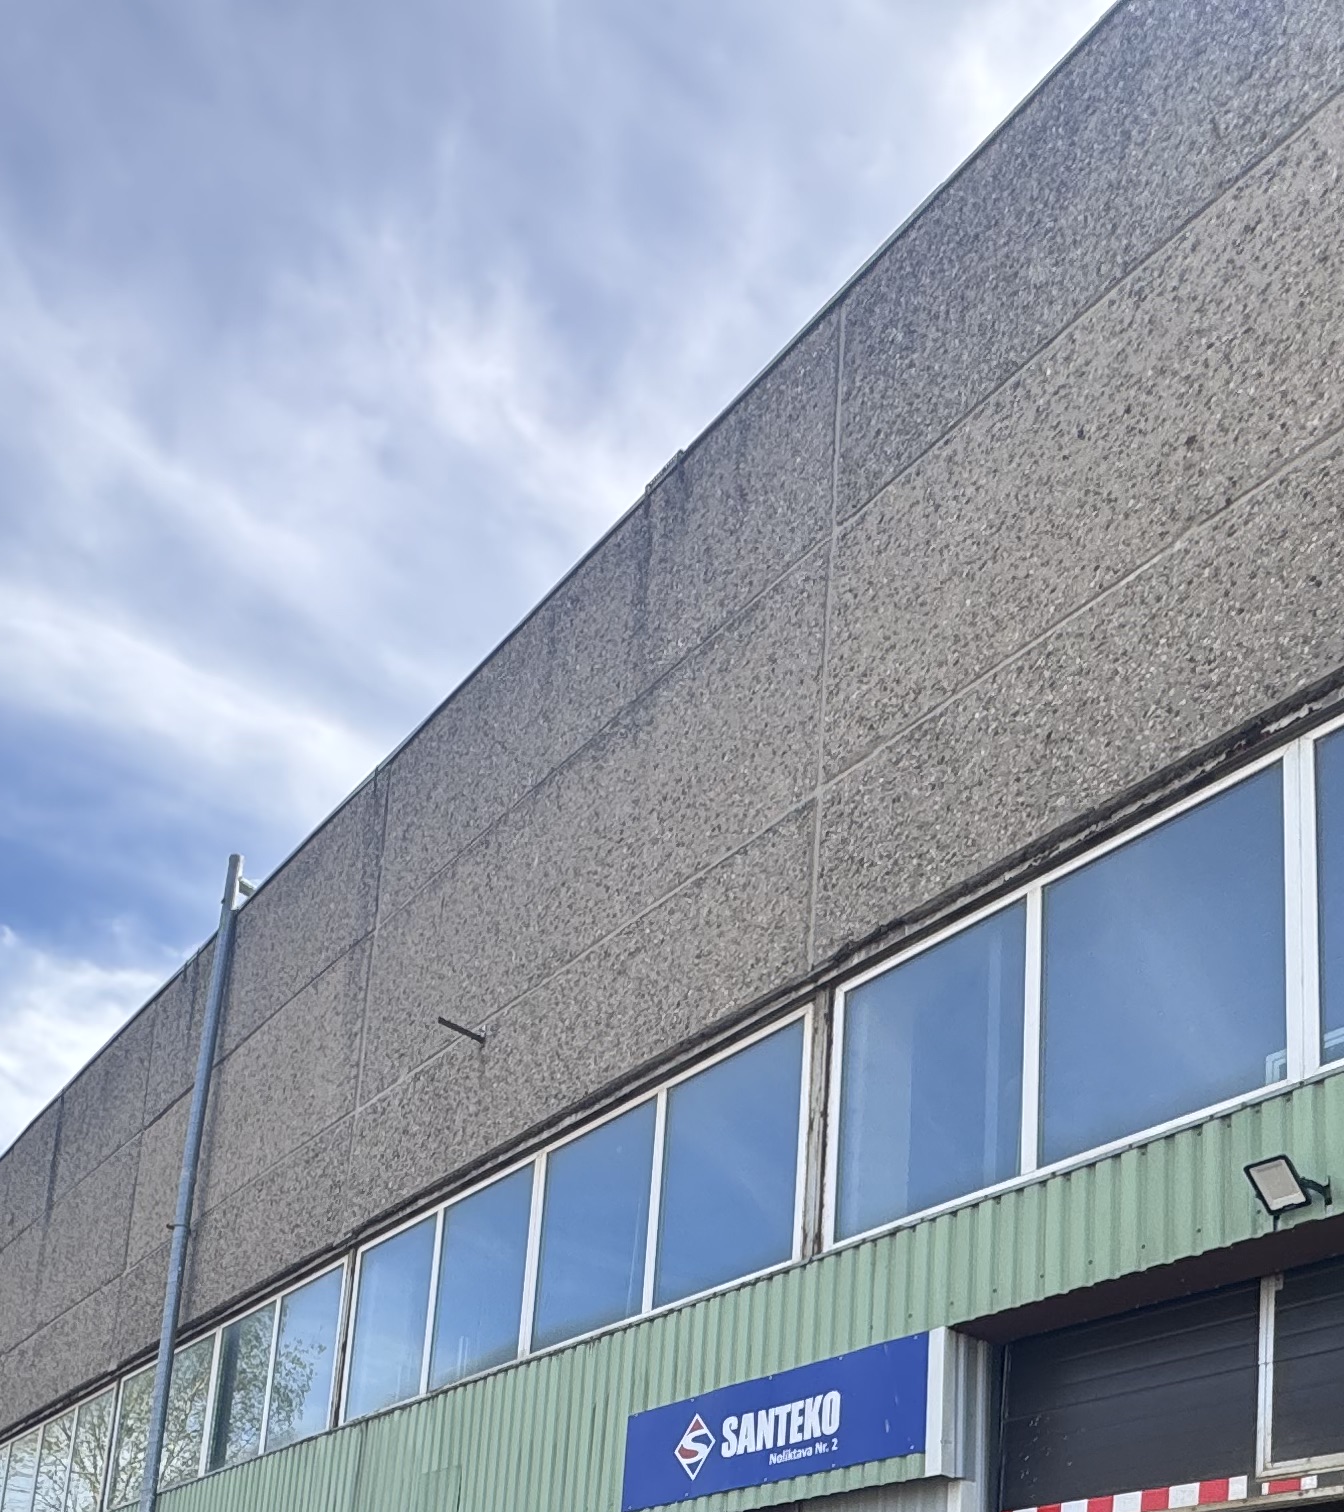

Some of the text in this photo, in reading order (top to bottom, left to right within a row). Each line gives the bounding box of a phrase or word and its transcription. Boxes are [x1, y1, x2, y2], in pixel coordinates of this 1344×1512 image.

[721, 1390, 841, 1458] SANTEKO
[768, 1437, 839, 1466] Noliktava Nr. 2
